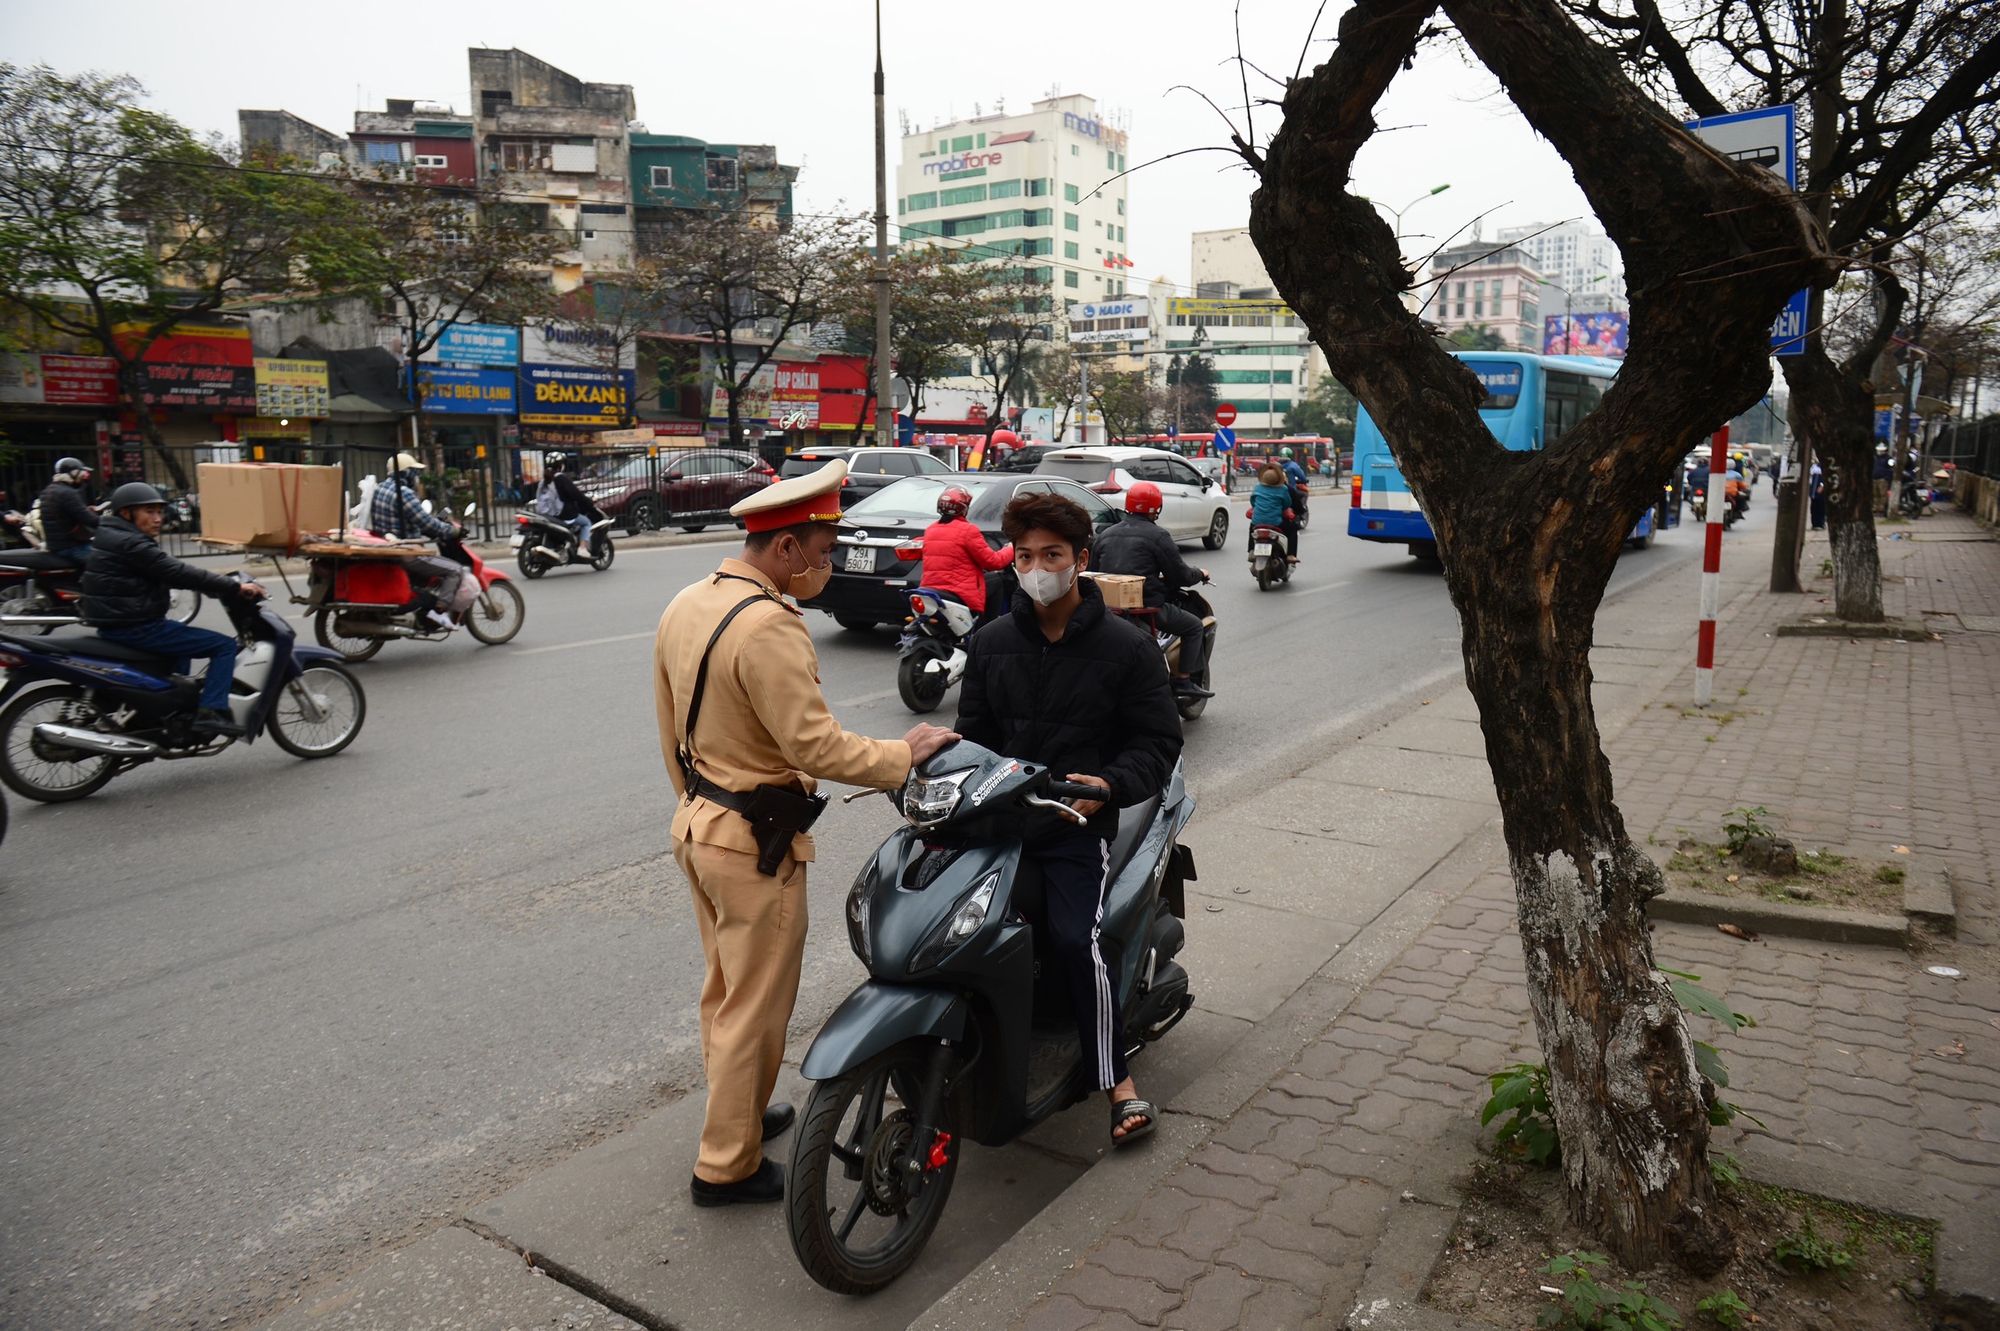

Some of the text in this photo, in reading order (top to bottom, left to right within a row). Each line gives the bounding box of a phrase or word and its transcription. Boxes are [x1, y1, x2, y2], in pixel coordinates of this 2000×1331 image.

[1064, 111, 1129, 149] mobifone
[923, 151, 1003, 176] mobifone
[1098, 303, 1133, 316] HADIC
[455, 381, 480, 402] ĐIỆN
[482, 386, 512, 403] LẠNH
[854, 548, 869, 559] 29A
